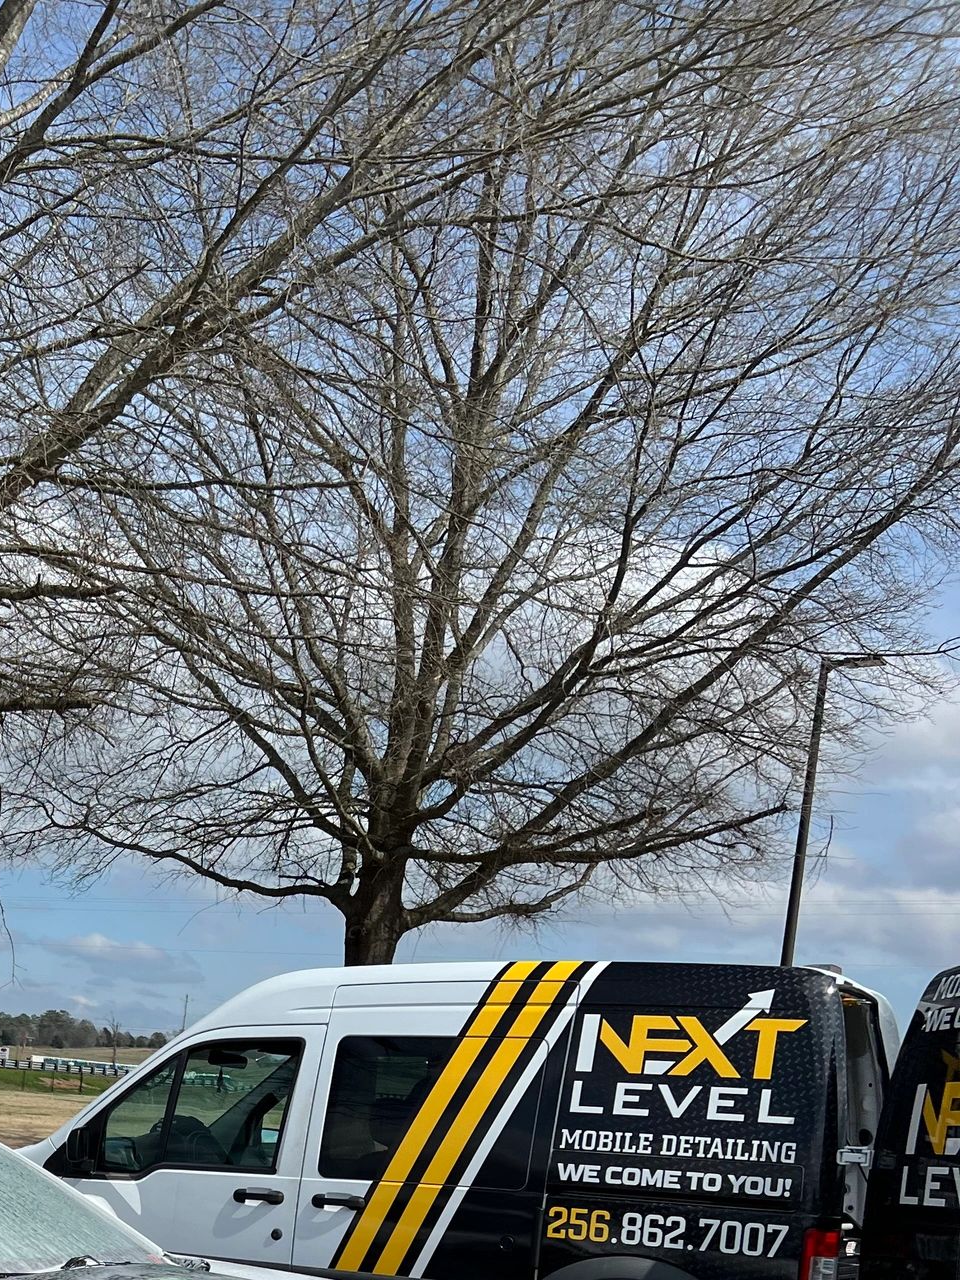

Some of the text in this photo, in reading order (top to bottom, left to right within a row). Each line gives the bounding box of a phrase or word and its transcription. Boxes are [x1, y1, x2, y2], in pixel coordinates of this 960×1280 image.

[924, 1007, 955, 1033] WE
[575, 1013, 809, 1079] NEXT
[569, 1080, 795, 1124] LEVEL
[559, 1128, 797, 1164] MOBILE DETAILING
[557, 1162, 792, 1197] WE COME TO YOU!
[546, 1206, 789, 1258] 256.862.7007
